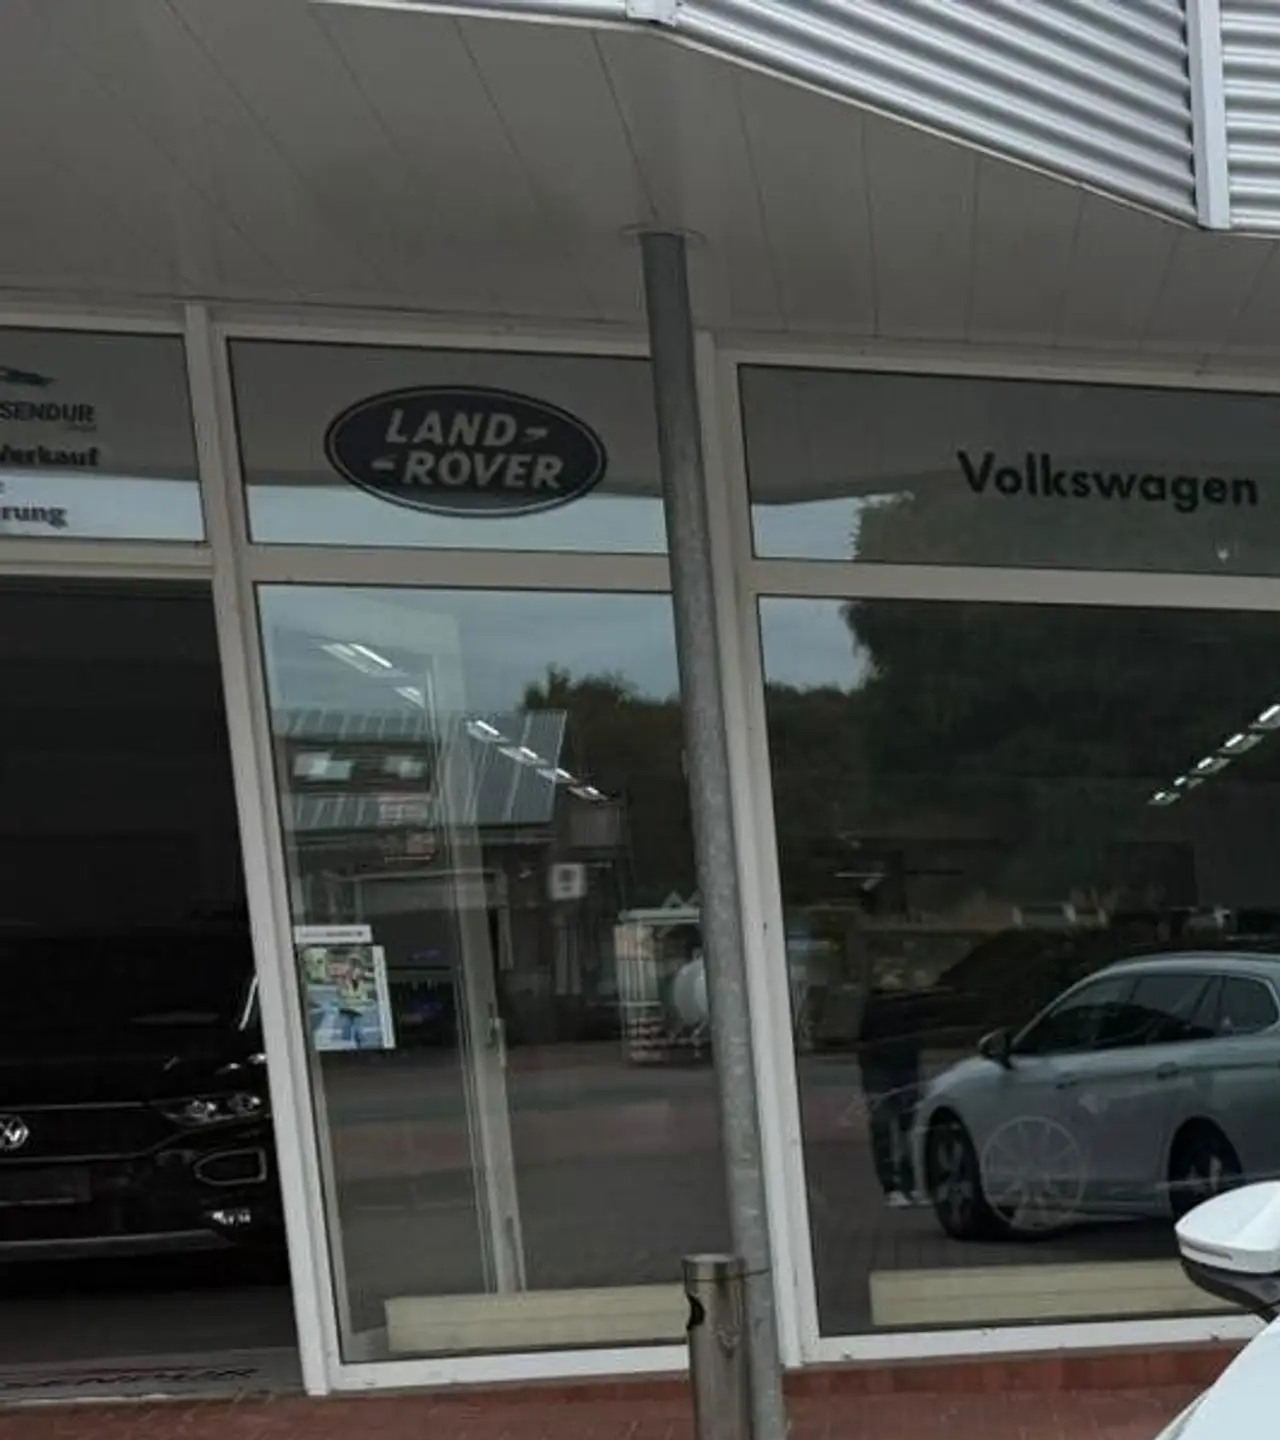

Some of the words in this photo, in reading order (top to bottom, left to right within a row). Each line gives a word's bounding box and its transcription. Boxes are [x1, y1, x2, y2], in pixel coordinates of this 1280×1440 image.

[0, 401, 96, 423] SENDUR
[956, 450, 1259, 513] Volkswagen
[0, 505, 69, 529] rung
